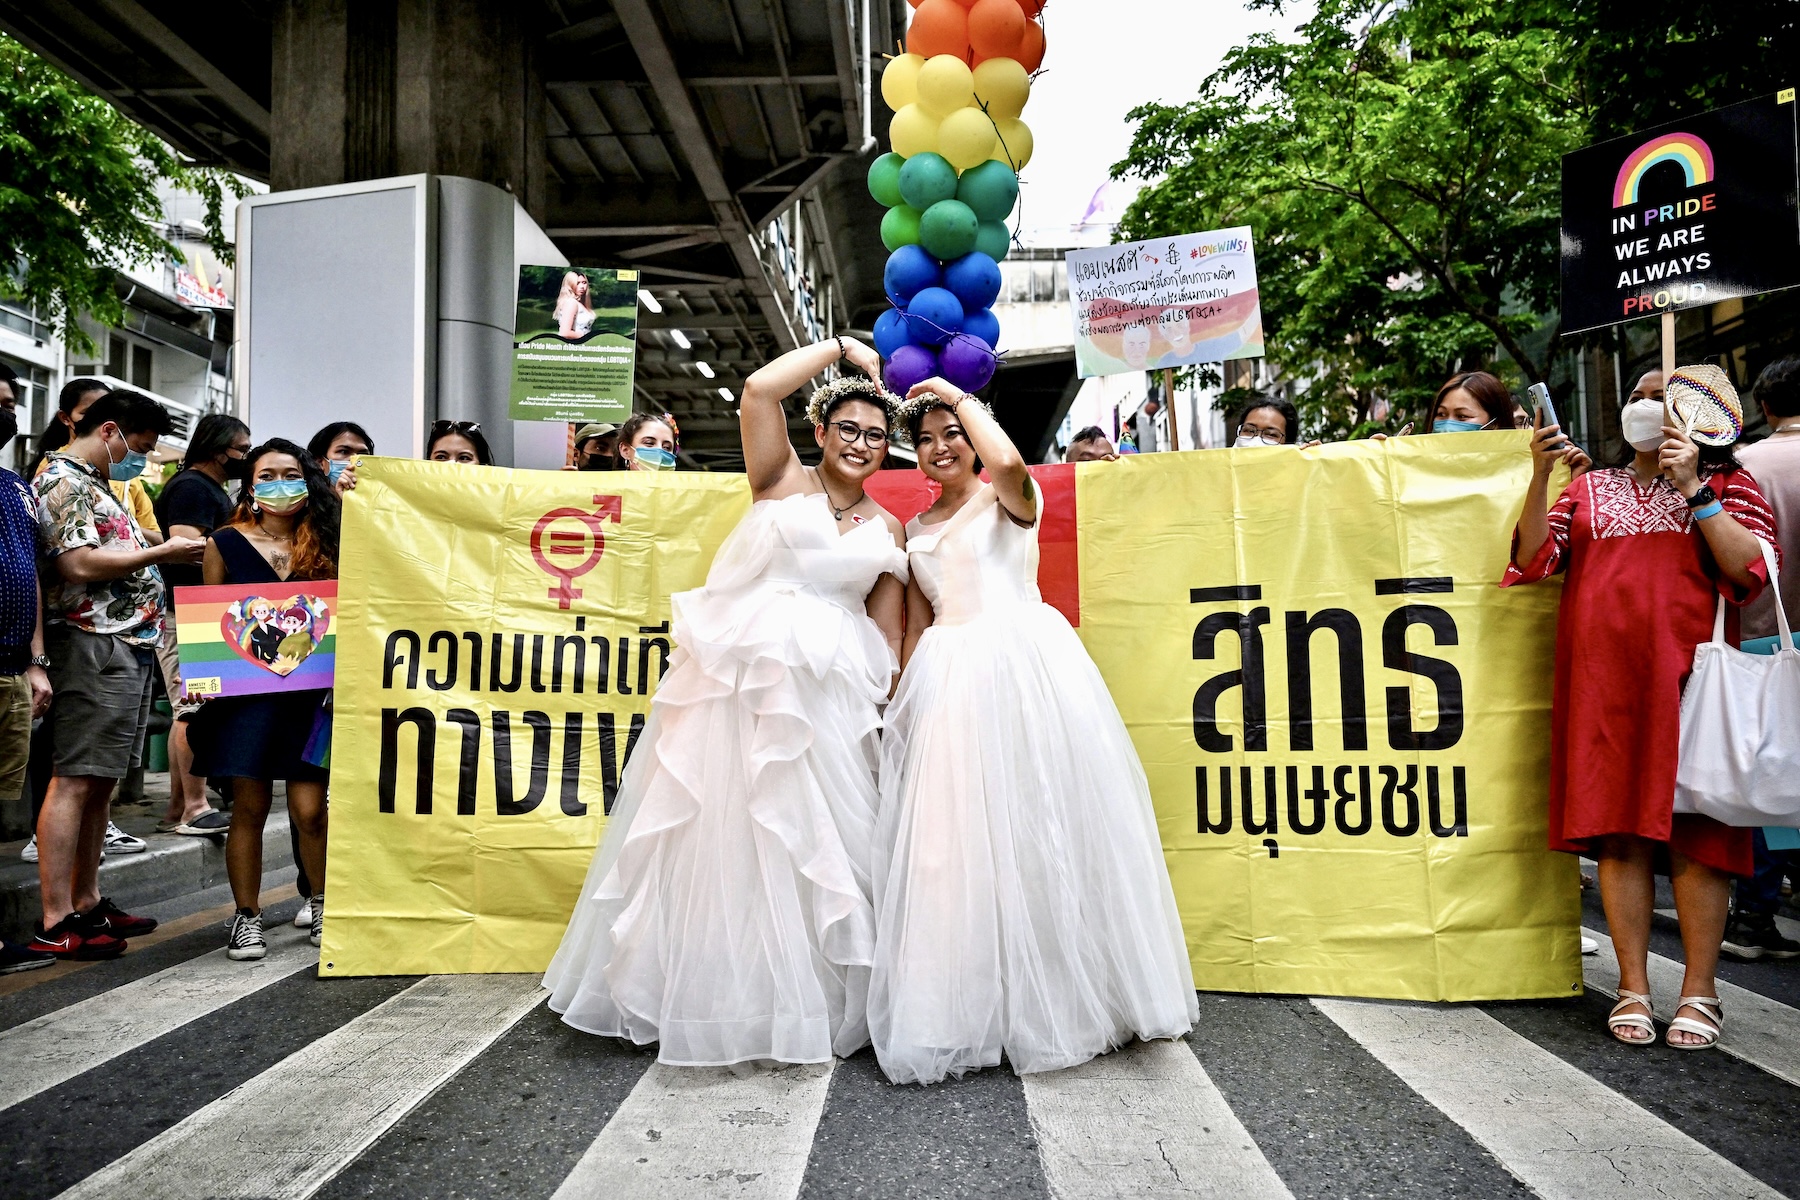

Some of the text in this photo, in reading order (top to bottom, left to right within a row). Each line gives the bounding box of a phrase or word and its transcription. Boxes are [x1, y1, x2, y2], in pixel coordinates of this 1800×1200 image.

[1612, 193, 1717, 235] IN PRIDE
[1615, 224, 1705, 261] WE ARE
[1617, 252, 1711, 289] ALWAYS
[1623, 282, 1707, 316] PROUD
[1190, 576, 1464, 753] สิทธิ
[1195, 764, 1469, 859] มนุษยชน
